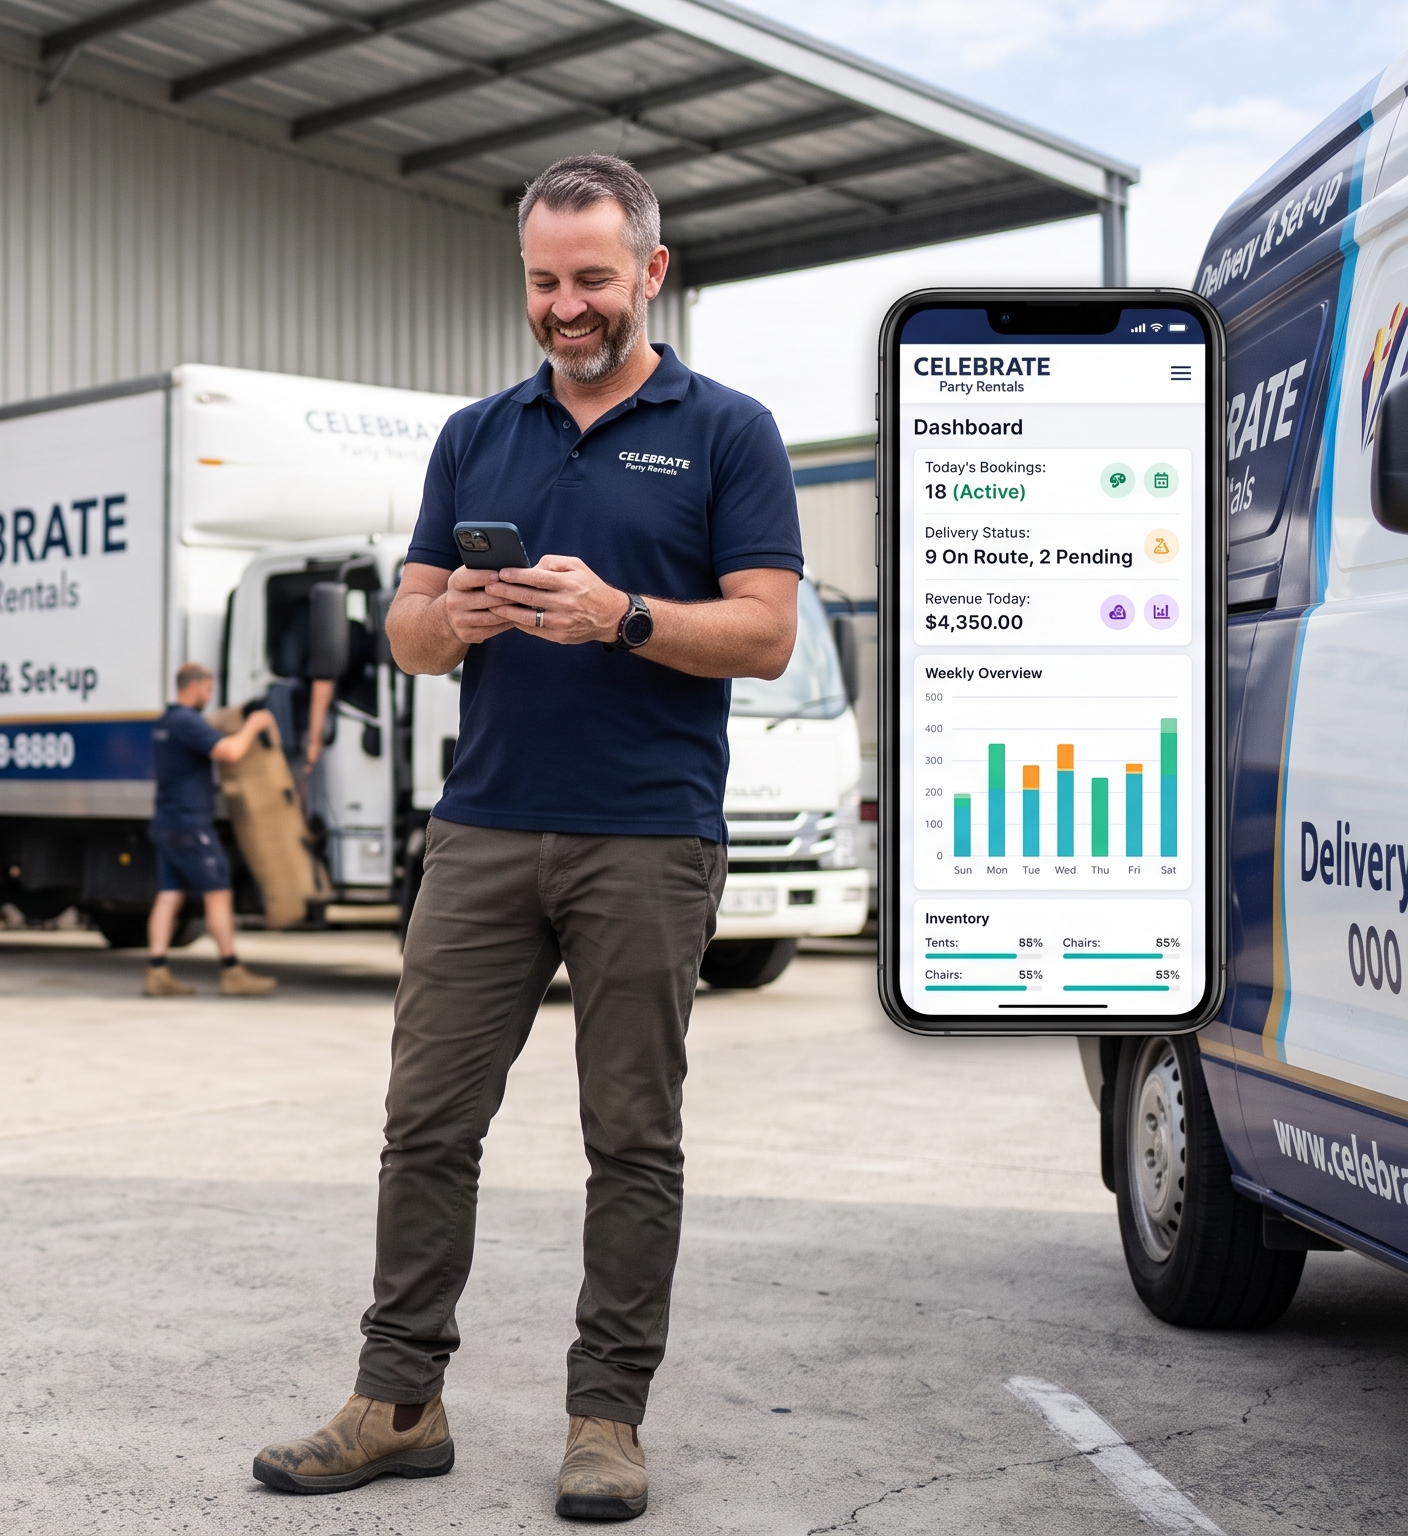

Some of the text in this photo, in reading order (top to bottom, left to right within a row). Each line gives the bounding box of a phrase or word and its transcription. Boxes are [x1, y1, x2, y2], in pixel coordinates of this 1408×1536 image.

[1197, 171, 1343, 298] Delivery & Set-up
[913, 356, 1051, 377] CELEBRATE
[939, 380, 1025, 396] Party Rentals
[1226, 358, 1307, 462] RATE
[914, 418, 1023, 436] Dashboard
[618, 451, 691, 469] CELEBRATE
[625, 462, 677, 476] Party Rentals
[924, 461, 1046, 476] Today's Bookings:
[925, 483, 1026, 502] 18 (Active)
[925, 526, 1030, 541] Delivery Status:
[925, 548, 1133, 569] 9 On Route, 2 Pending
[925, 592, 1030, 608] Revenue Today:
[925, 613, 1023, 633] $4,350.00
[20, 660, 98, 701] Set-up
[925, 666, 1043, 682] Weekly Overview
[925, 692, 944, 702] 500
[924, 724, 944, 733] 400
[925, 755, 943, 765] 300
[925, 787, 943, 797] 200
[925, 819, 943, 829] 100
[936, 851, 944, 861] 0
[953, 865, 1177, 875] Sun Mon Tue Wed Thu Fri Sat
[925, 912, 990, 927] Inventory
[924, 937, 959, 948] Tents:
[1062, 937, 1101, 948] Chairs:
[1348, 922, 1402, 995] 000
[924, 969, 1044, 980] Chairs: 55%
